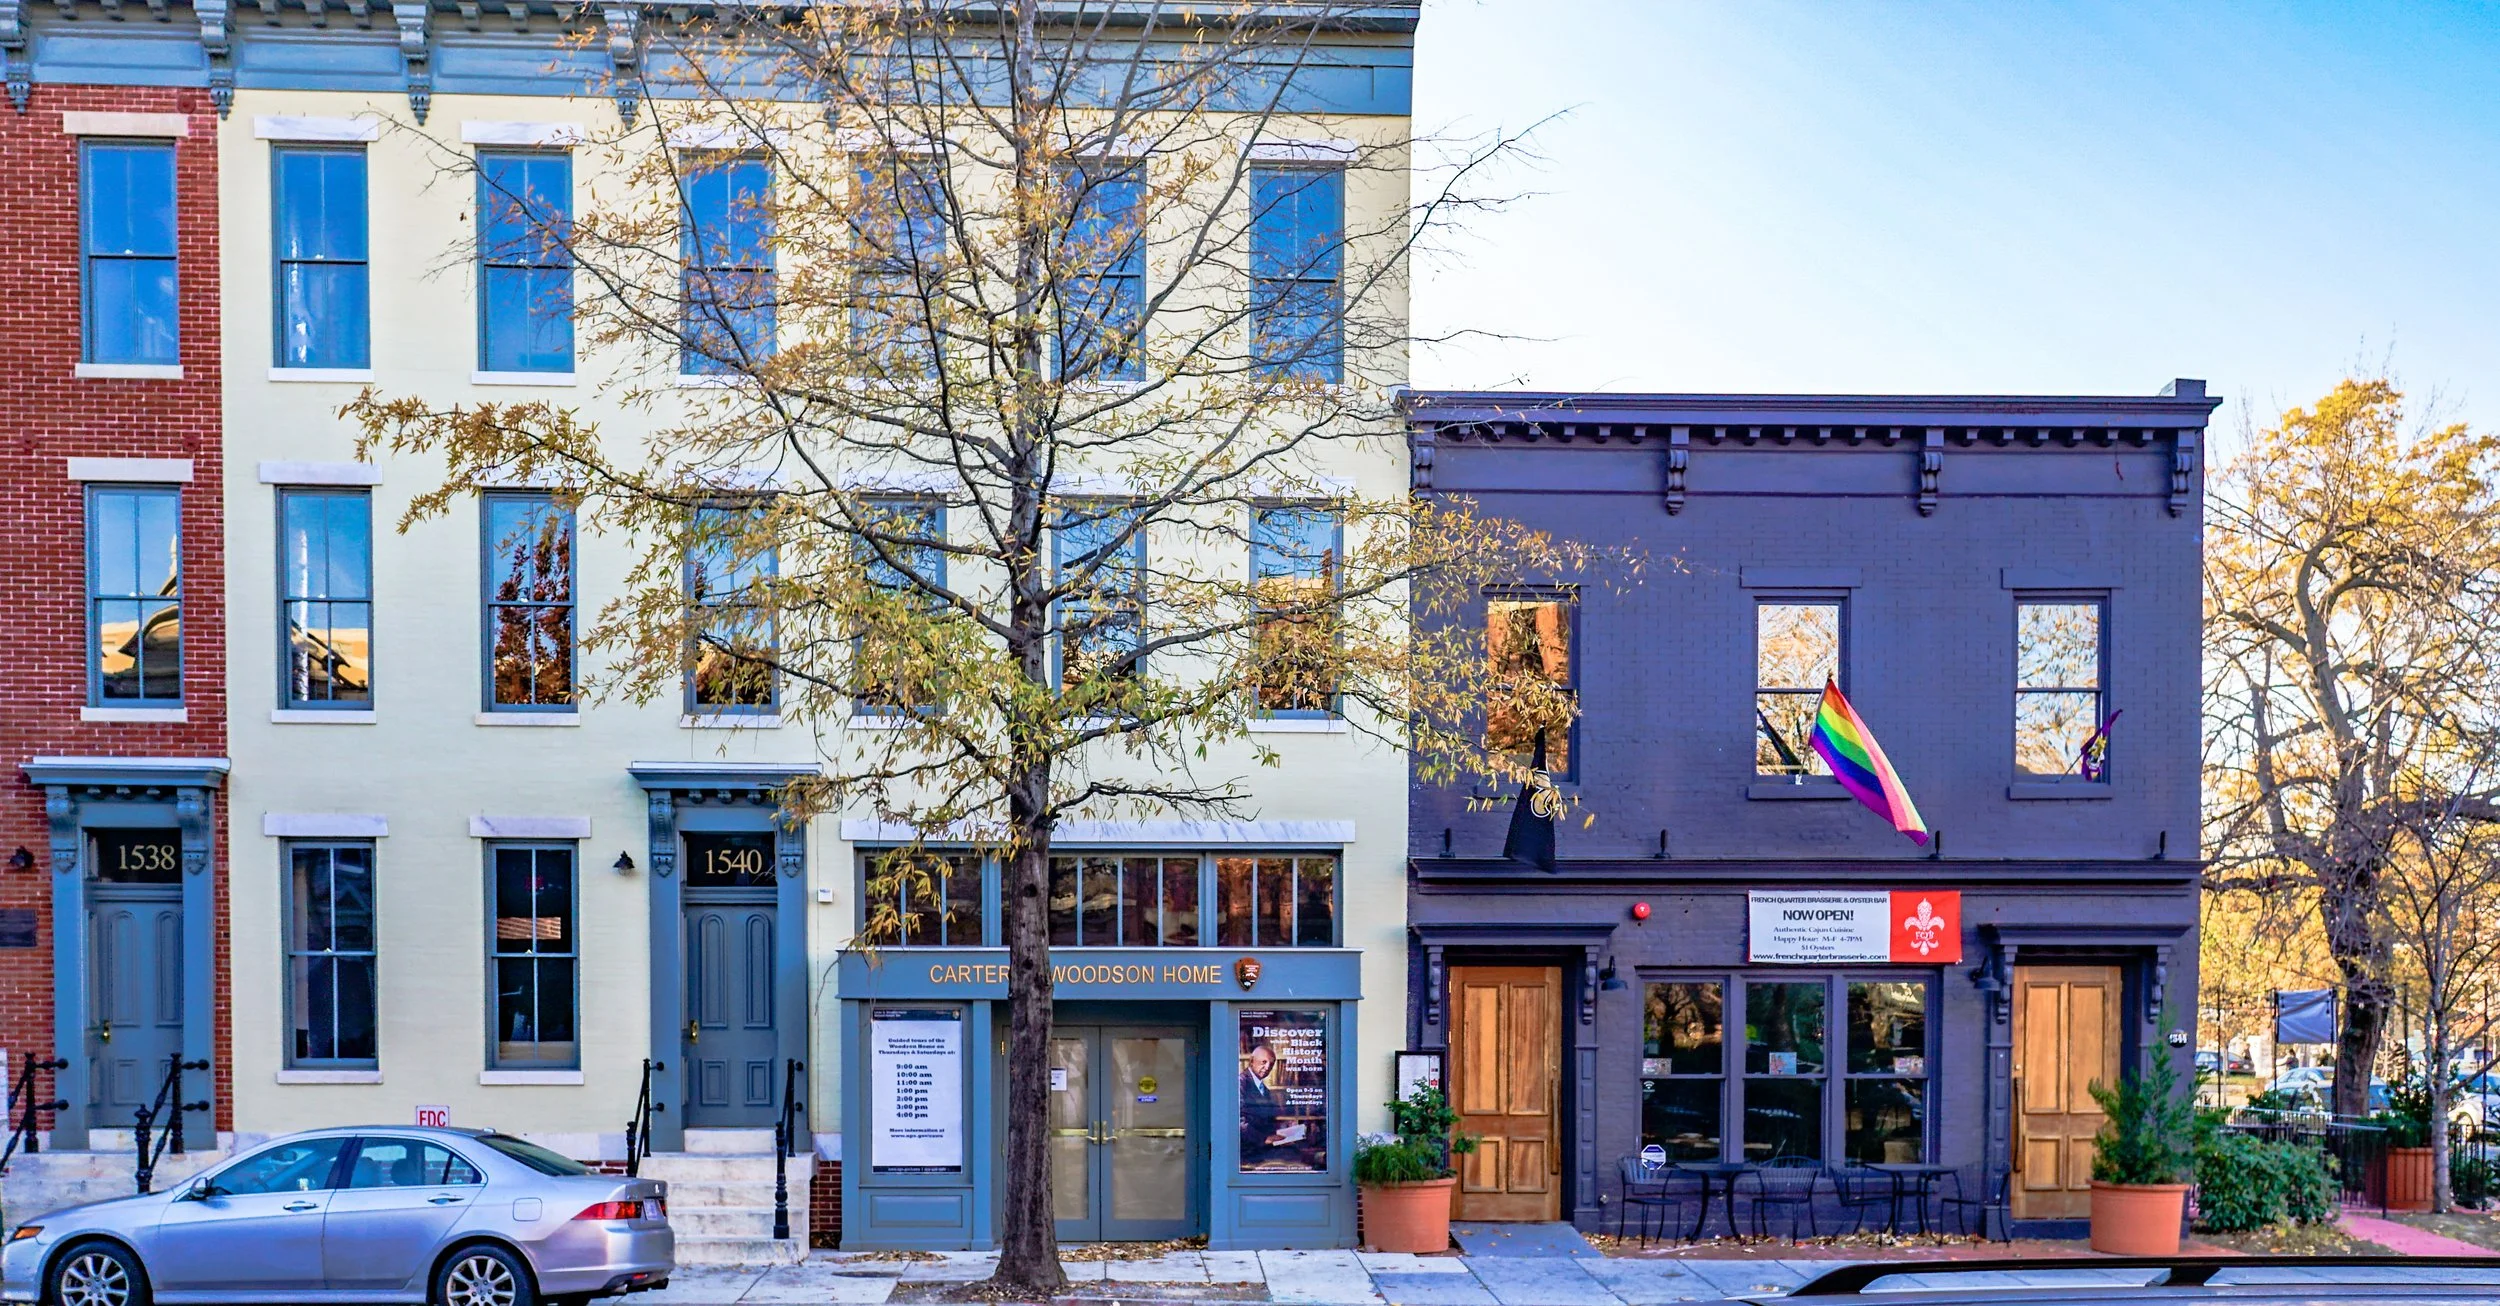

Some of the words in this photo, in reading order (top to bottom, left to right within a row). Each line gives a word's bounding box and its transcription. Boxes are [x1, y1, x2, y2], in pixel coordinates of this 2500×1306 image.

[119, 844, 176, 870] 1538
[705, 848, 763, 875] 1540
[1777, 896, 1807, 904] QUARTER
[1807, 896, 1843, 904] BRASSERIE
[1843, 896, 1849, 904] &
[1849, 896, 1874, 904] OYSTER
[1783, 909, 1815, 921] NOW
[1815, 909, 1854, 921] OPEN!
[1808, 926, 1829, 934] Cajun
[1773, 936, 1797, 944] Happy
[1809, 944, 1835, 952] Oysters
[1753, 953, 1888, 961] www.frenchquarterbrasserie.com
[929, 964, 1011, 984] CARTER
[1051, 964, 1156, 984] WOODSON
[1163, 965, 1223, 983] HOME
[1252, 1026, 1323, 1037] Discover
[2169, 1033, 2188, 1044] 1544
[1282, 1048, 1323, 1057] History
[419, 1110, 446, 1127] FDC
